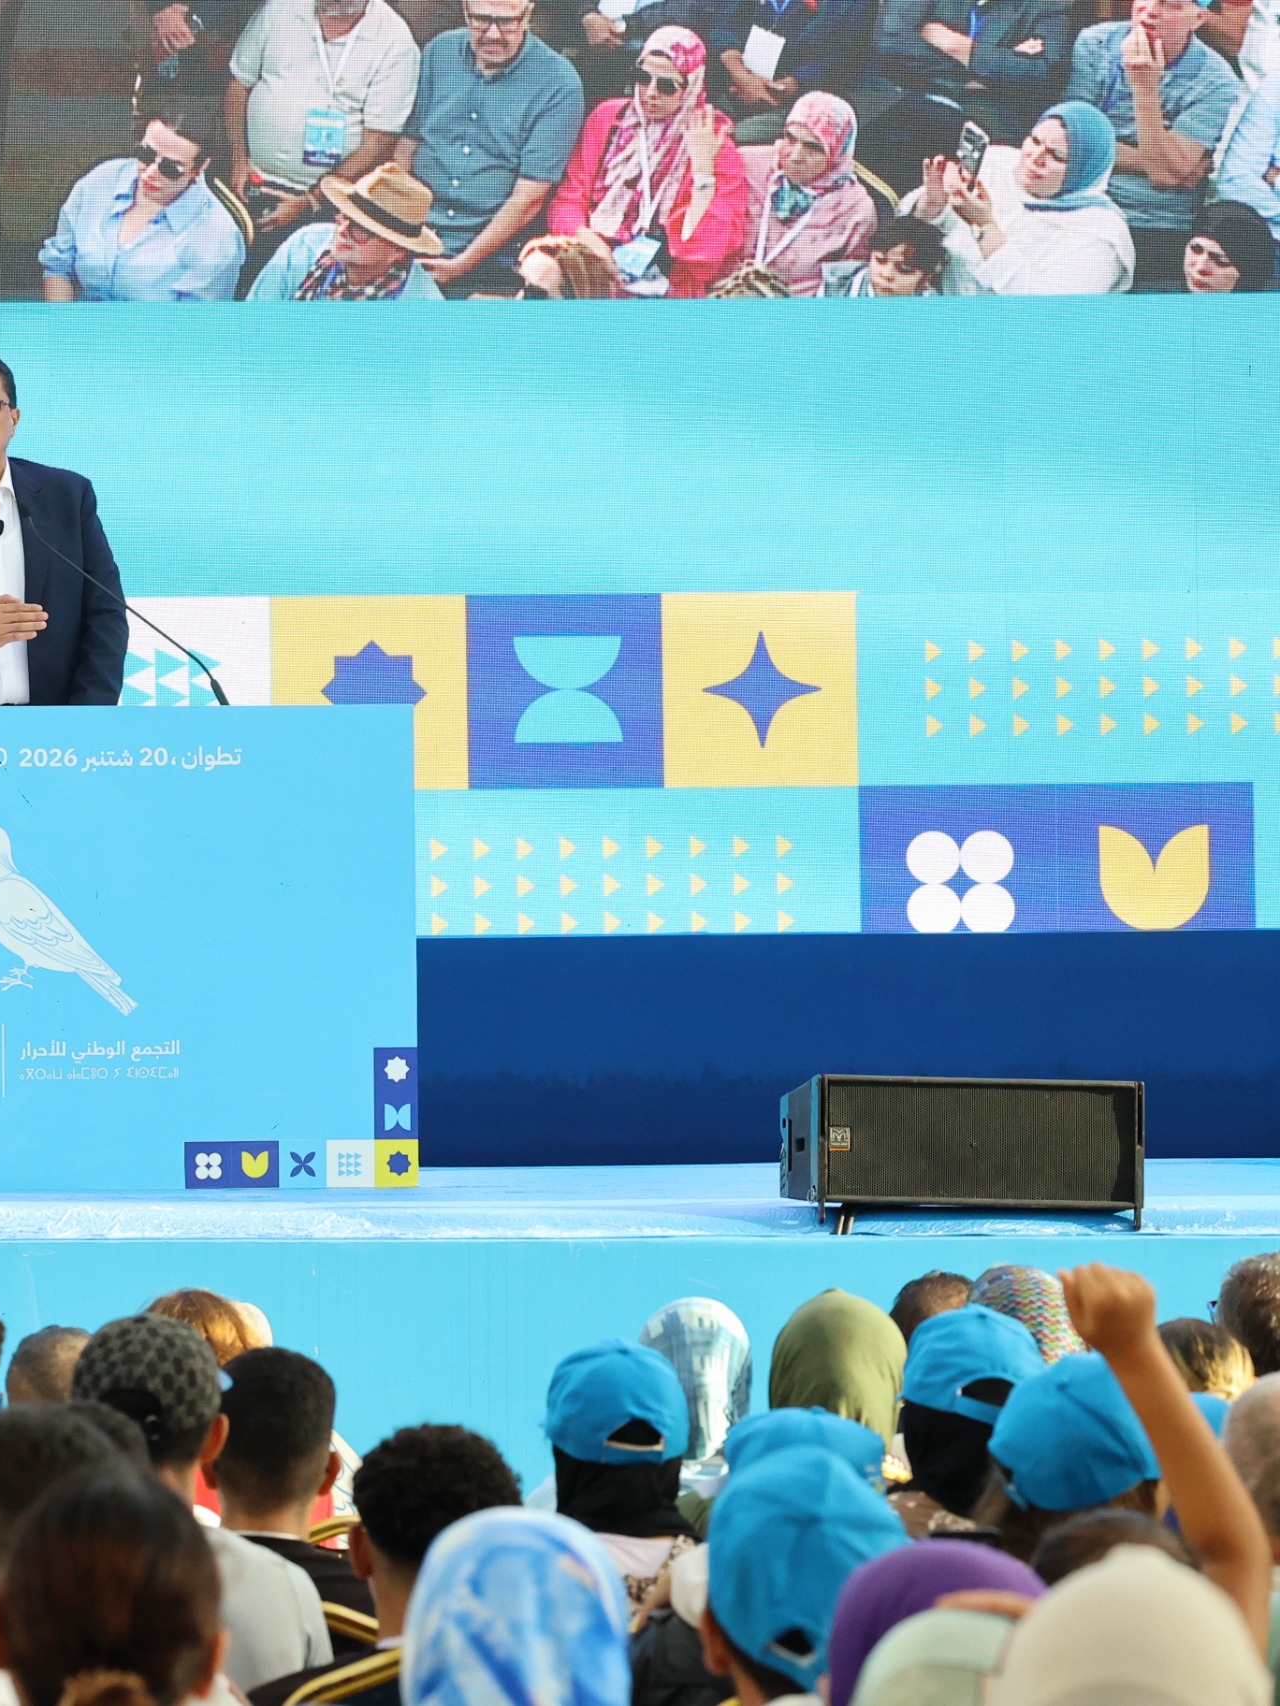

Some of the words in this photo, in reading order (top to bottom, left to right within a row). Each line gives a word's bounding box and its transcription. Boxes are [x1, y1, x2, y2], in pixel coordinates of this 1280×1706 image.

[19, 748, 78, 767] 2026
[81, 749, 133, 772] شتنبر
[182, 746, 242, 771] تطوان
[20, 1040, 66, 1061] للأحرار
[71, 1040, 125, 1063] الوطني
[130, 1040, 180, 1062] التجمع
